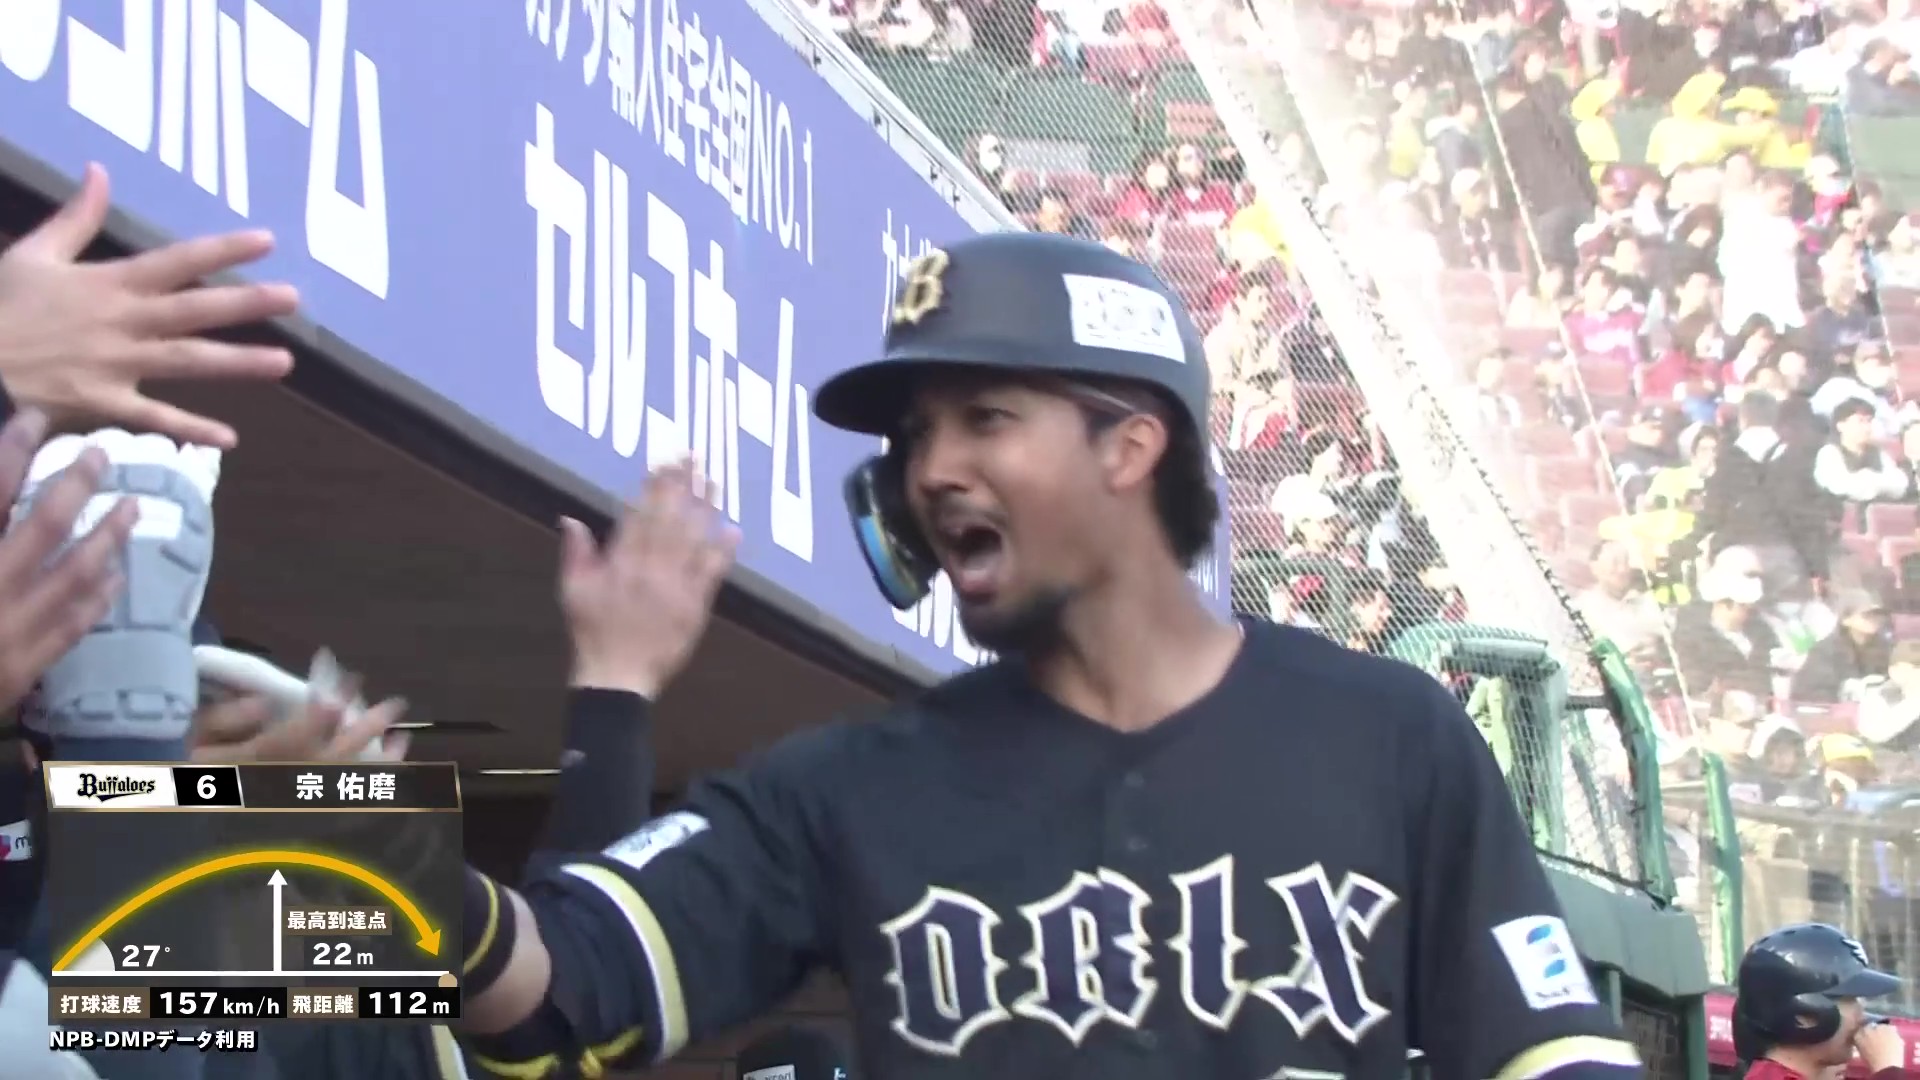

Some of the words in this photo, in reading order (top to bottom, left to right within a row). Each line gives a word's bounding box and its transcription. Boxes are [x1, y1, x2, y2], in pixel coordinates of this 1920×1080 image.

[525, 102, 814, 563] セルコホーム
[880, 854, 1399, 1057] ORIX
